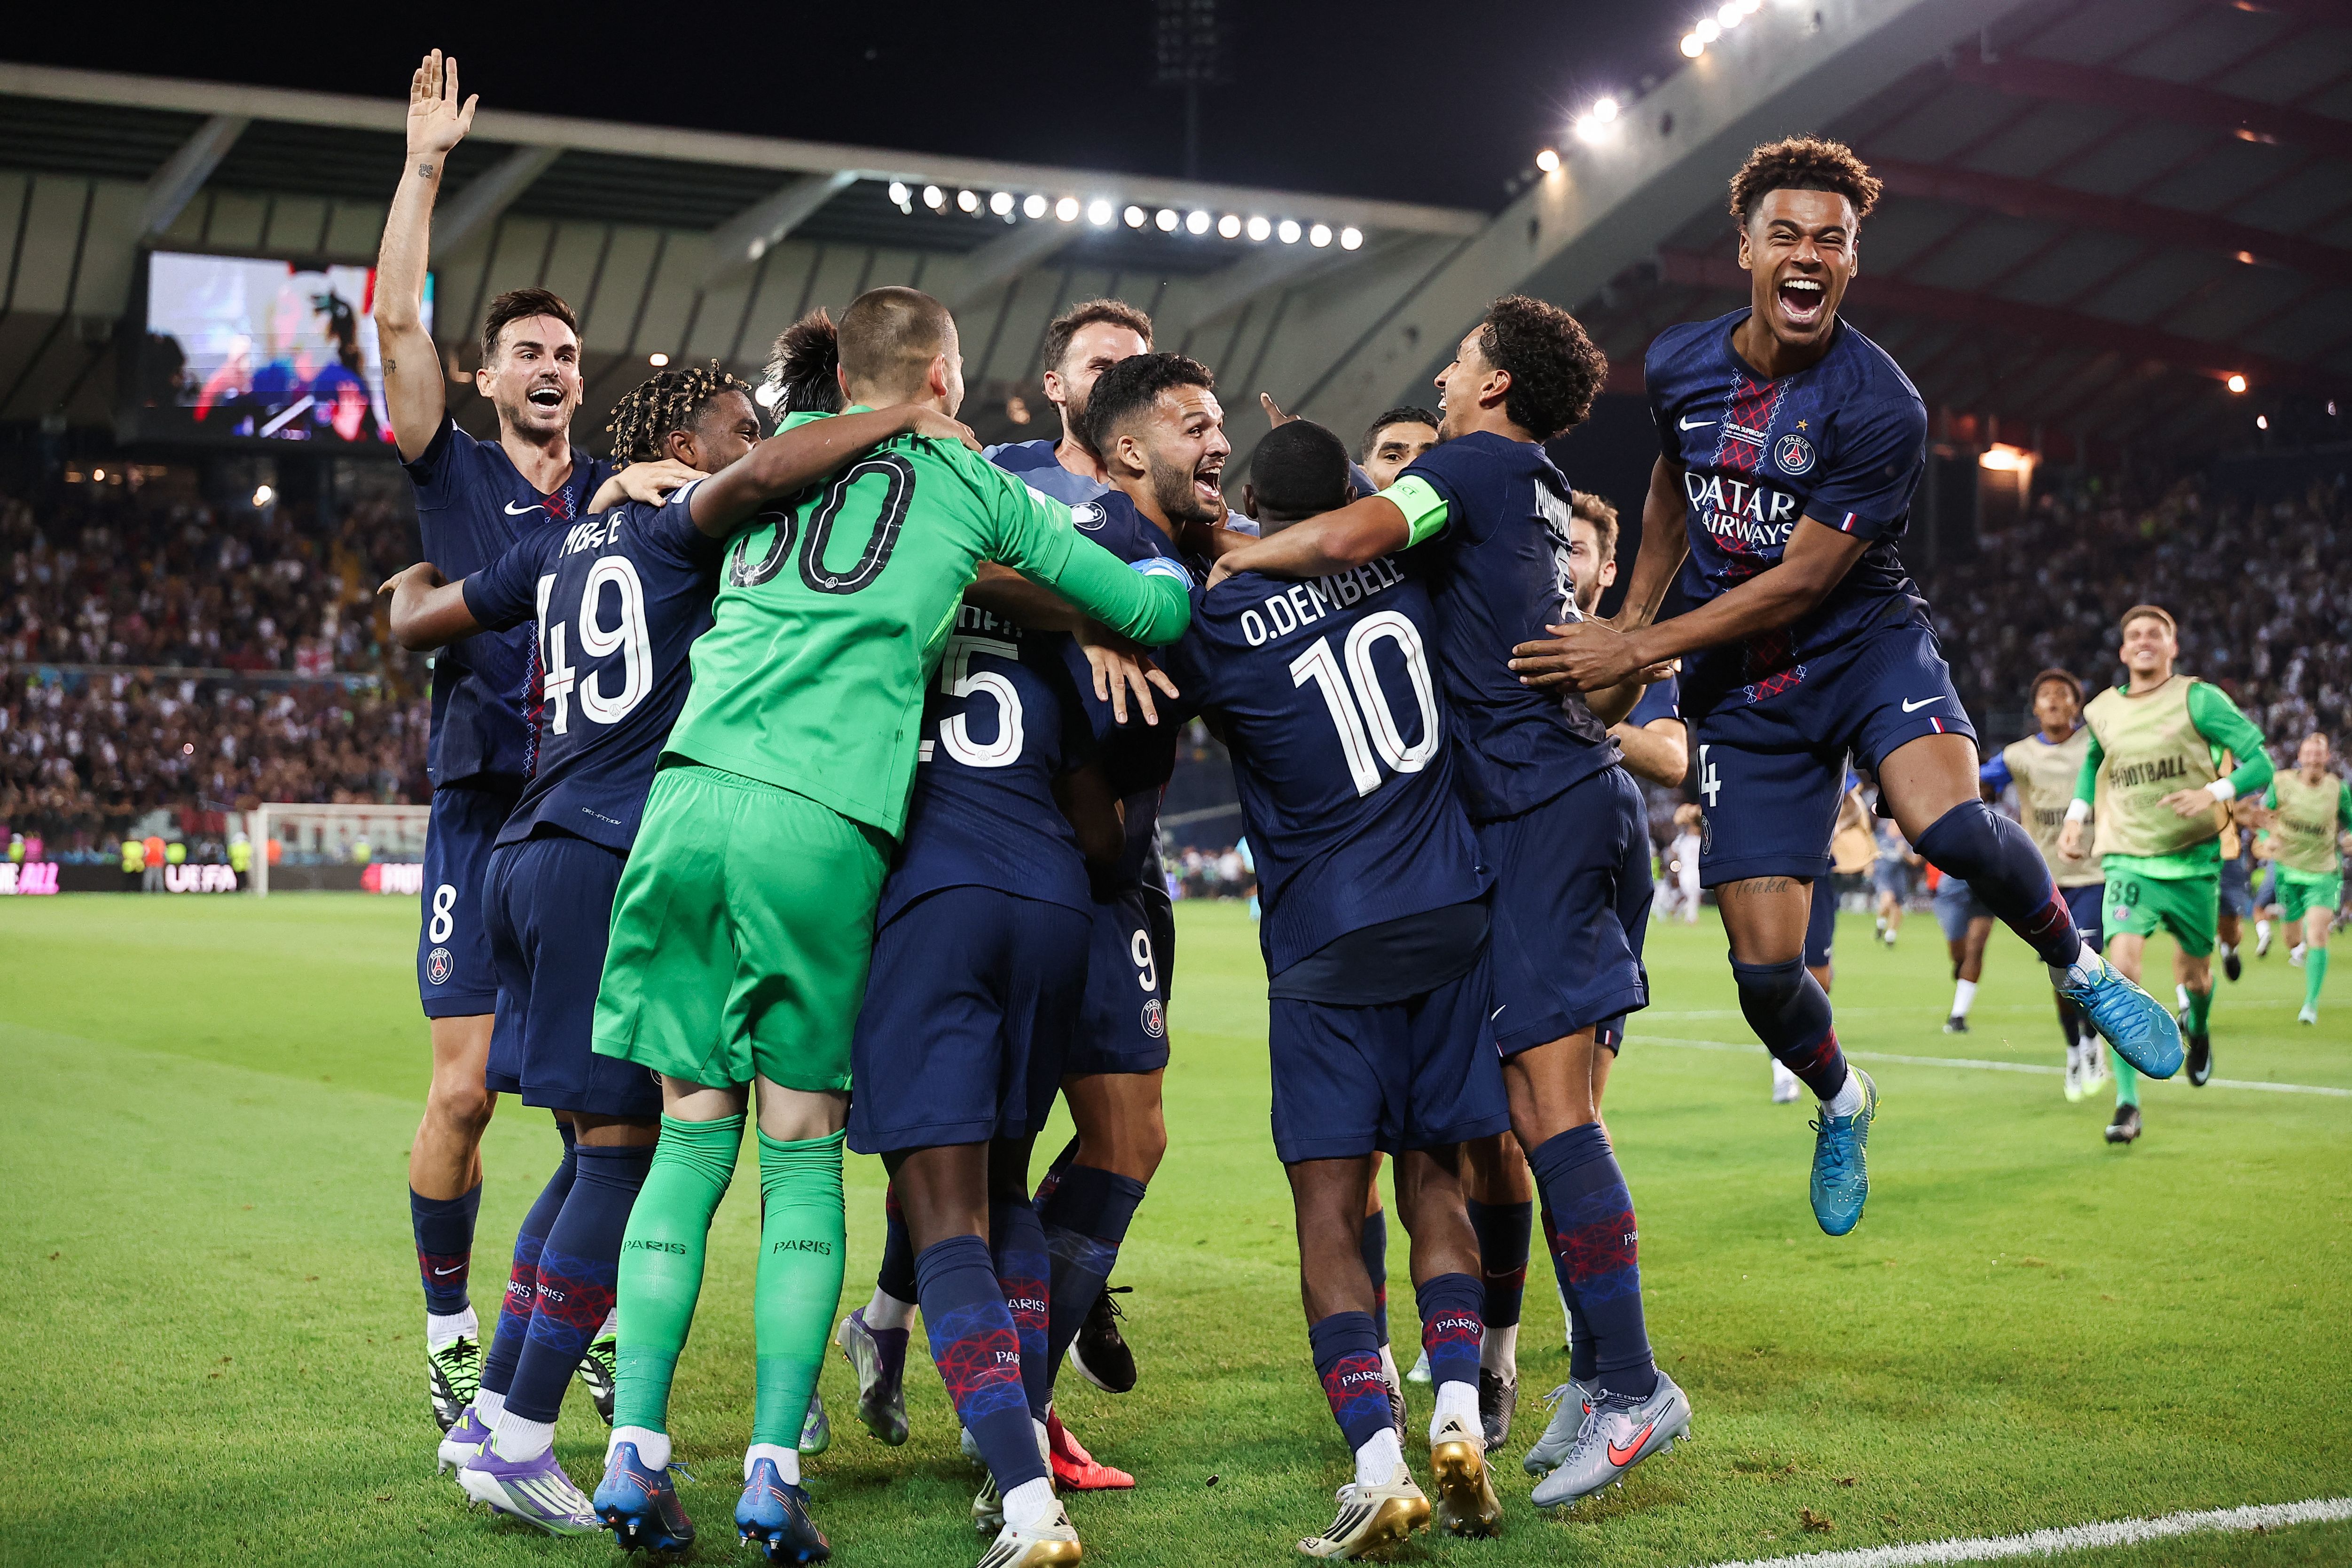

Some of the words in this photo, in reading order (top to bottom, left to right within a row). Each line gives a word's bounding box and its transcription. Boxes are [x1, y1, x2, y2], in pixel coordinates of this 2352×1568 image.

[1784, 436, 1809, 449] PARIS
[1685, 471, 1795, 522] QATAR
[1702, 511, 1793, 545] AIRWAYS
[537, 556, 653, 735] 49
[919, 635, 1024, 768] 5
[1289, 610, 1439, 797] 10
[165, 864, 237, 893] UEFA
[429, 884, 457, 944] 8
[431, 949, 448, 960] PARIS
[1131, 929, 1157, 992] 9
[1145, 1001, 1160, 1011] PARIS
[623, 1240, 687, 1255] PARIS
[774, 1239, 832, 1255] PARIS
[507, 1280, 532, 1298] ARIS
[536, 1282, 565, 1302] ARIS
[1008, 1298, 1045, 1312] ARIS
[1436, 1317, 1479, 1335] PARIS
[996, 1350, 1020, 1367] PAR
[1342, 1371, 1385, 1387] PARIS
[1607, 1391, 1648, 1402] IKEGRIP
